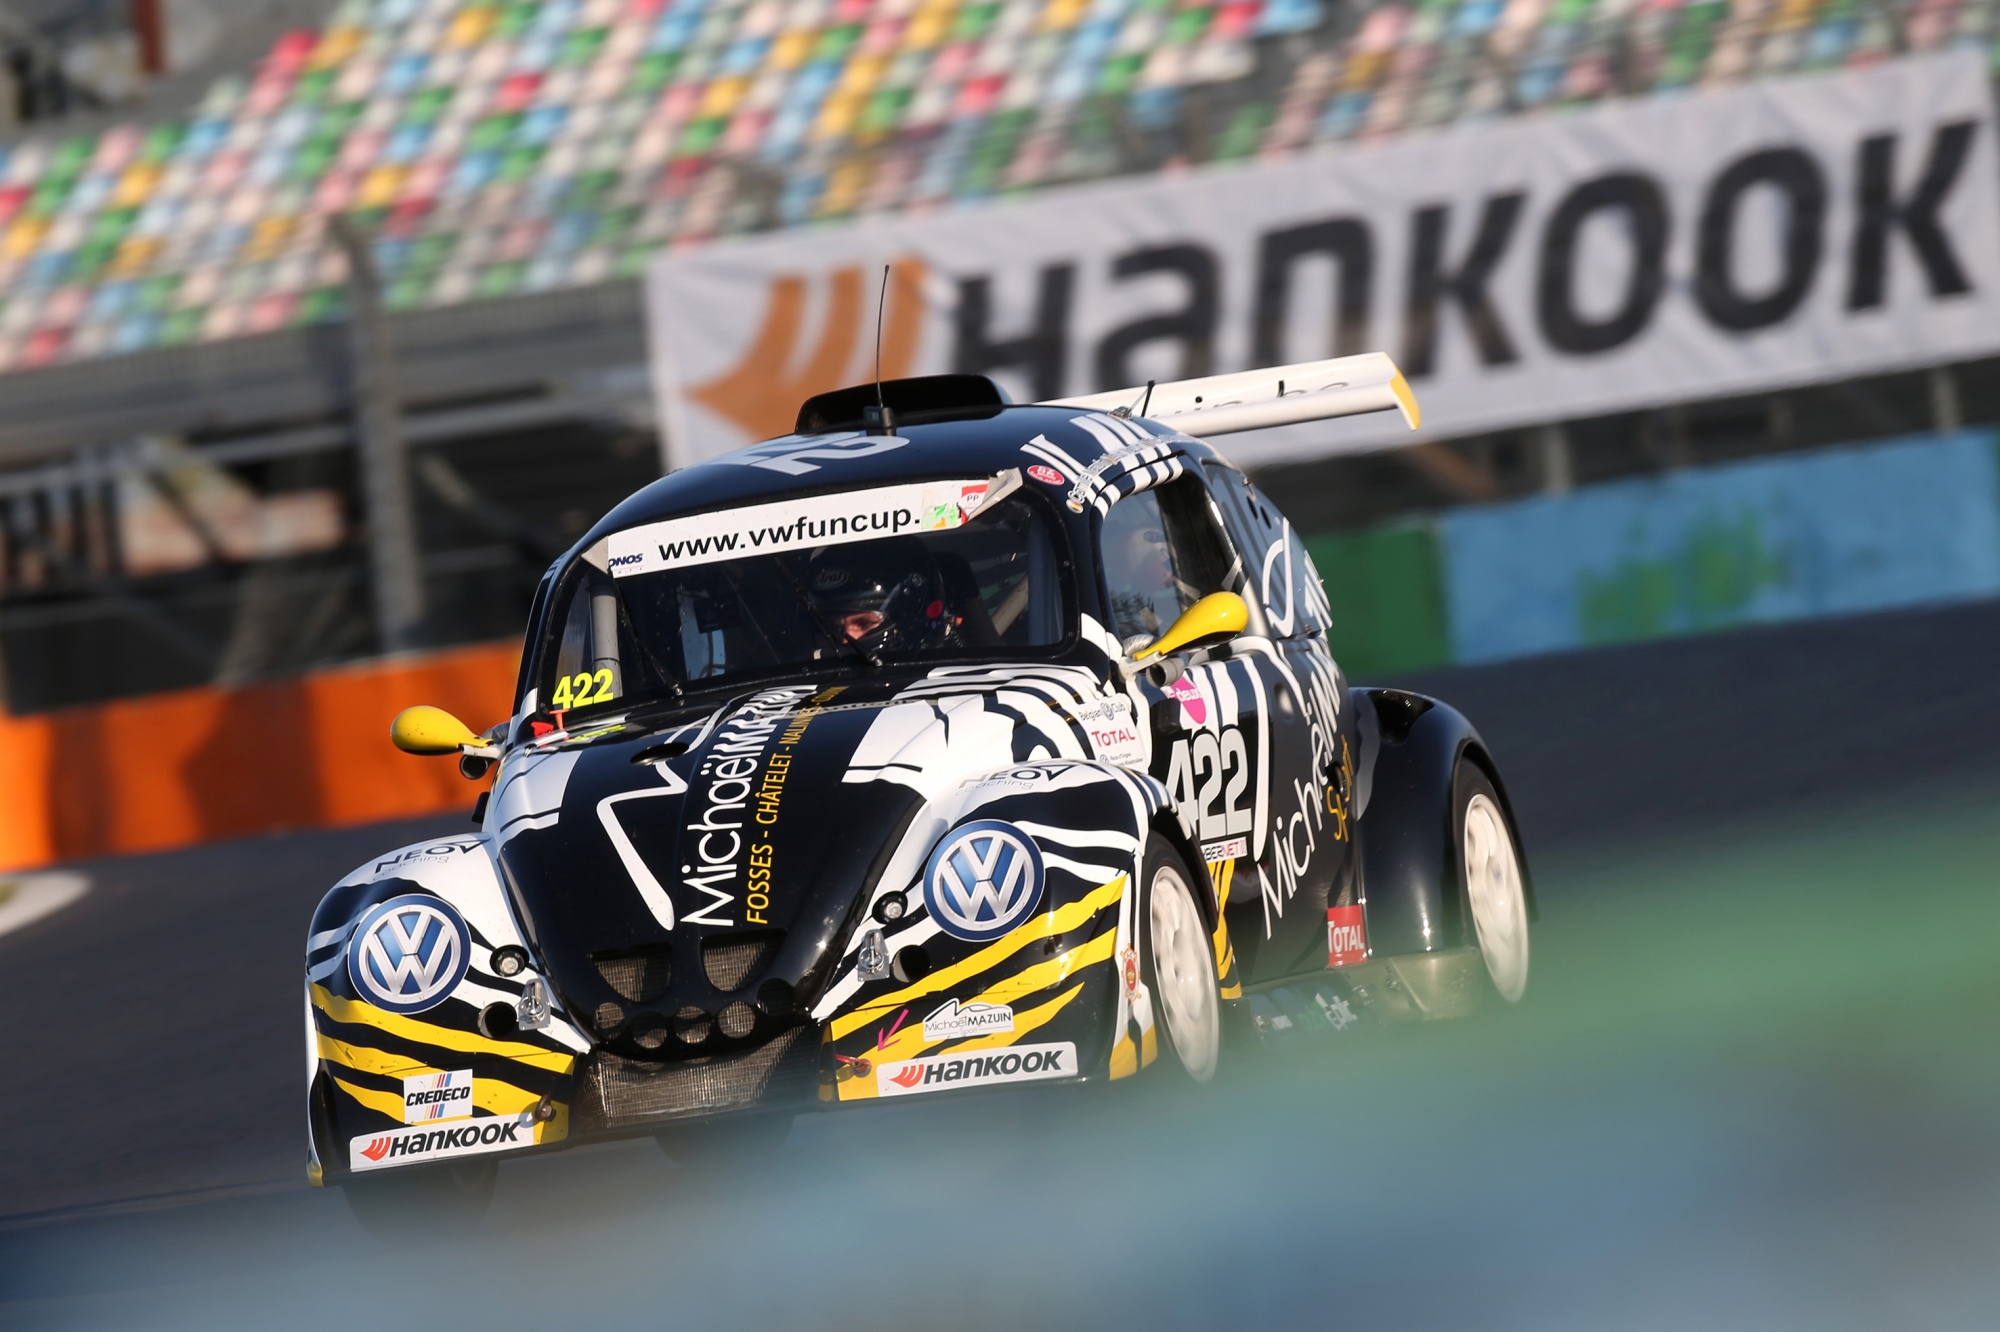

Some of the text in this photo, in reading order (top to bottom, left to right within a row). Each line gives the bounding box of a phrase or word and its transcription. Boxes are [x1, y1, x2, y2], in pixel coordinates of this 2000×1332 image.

[659, 506, 920, 561] www.vwfuncup.
[552, 668, 614, 710] 422
[1091, 727, 1136, 748] TOTAL
[1166, 728, 1252, 841] 422
[747, 843, 773, 925] FOSSES
[1327, 920, 1365, 953] TOTAL
[406, 1086, 471, 1107] CREDECO
